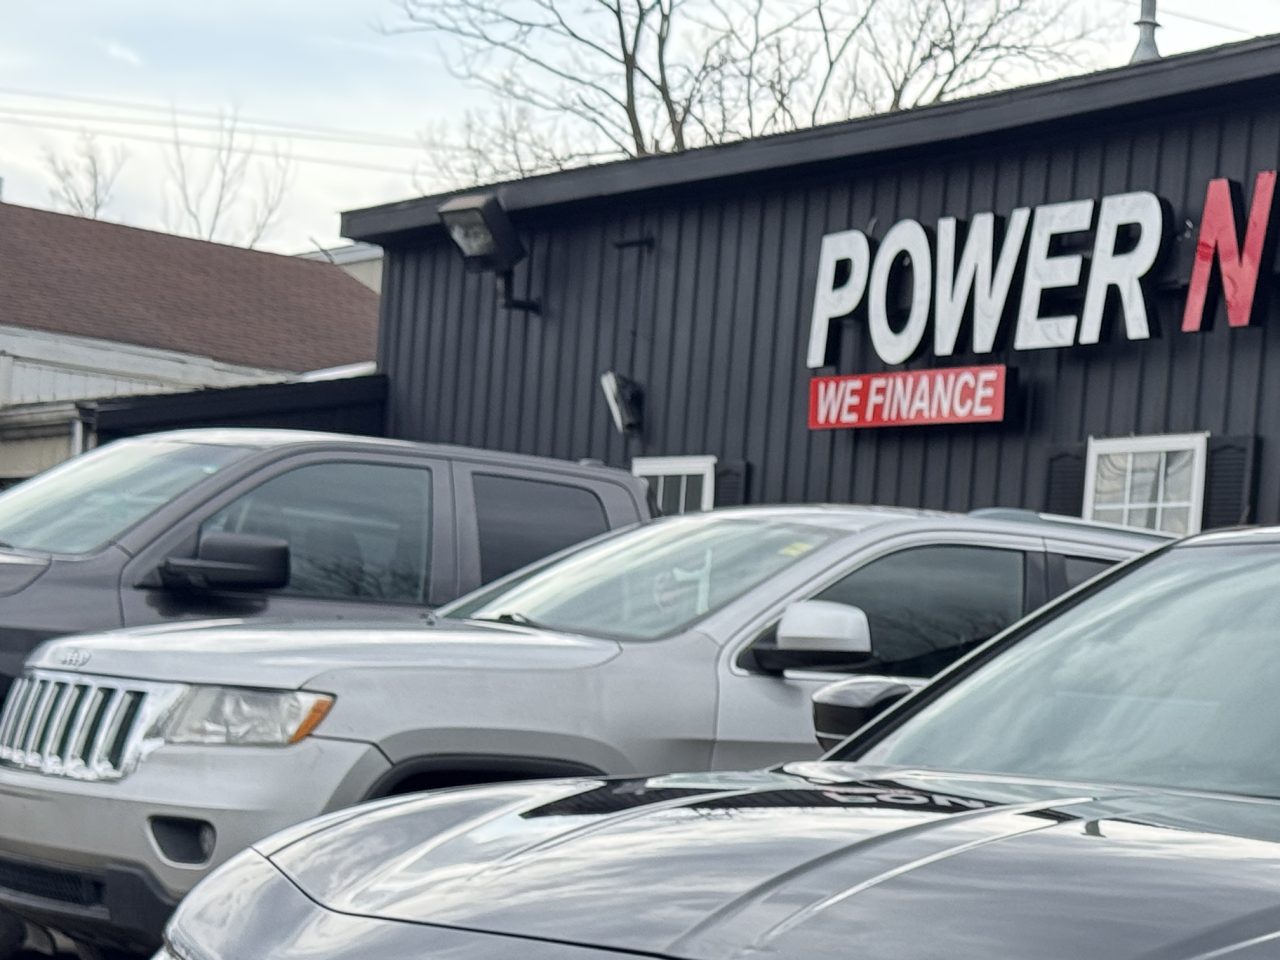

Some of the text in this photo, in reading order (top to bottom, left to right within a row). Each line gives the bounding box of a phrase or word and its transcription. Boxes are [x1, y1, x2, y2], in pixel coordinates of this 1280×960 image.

[806, 190, 1163, 368] POWER
[1181, 170, 1277, 332] N
[817, 370, 997, 424] WE FINANCE
